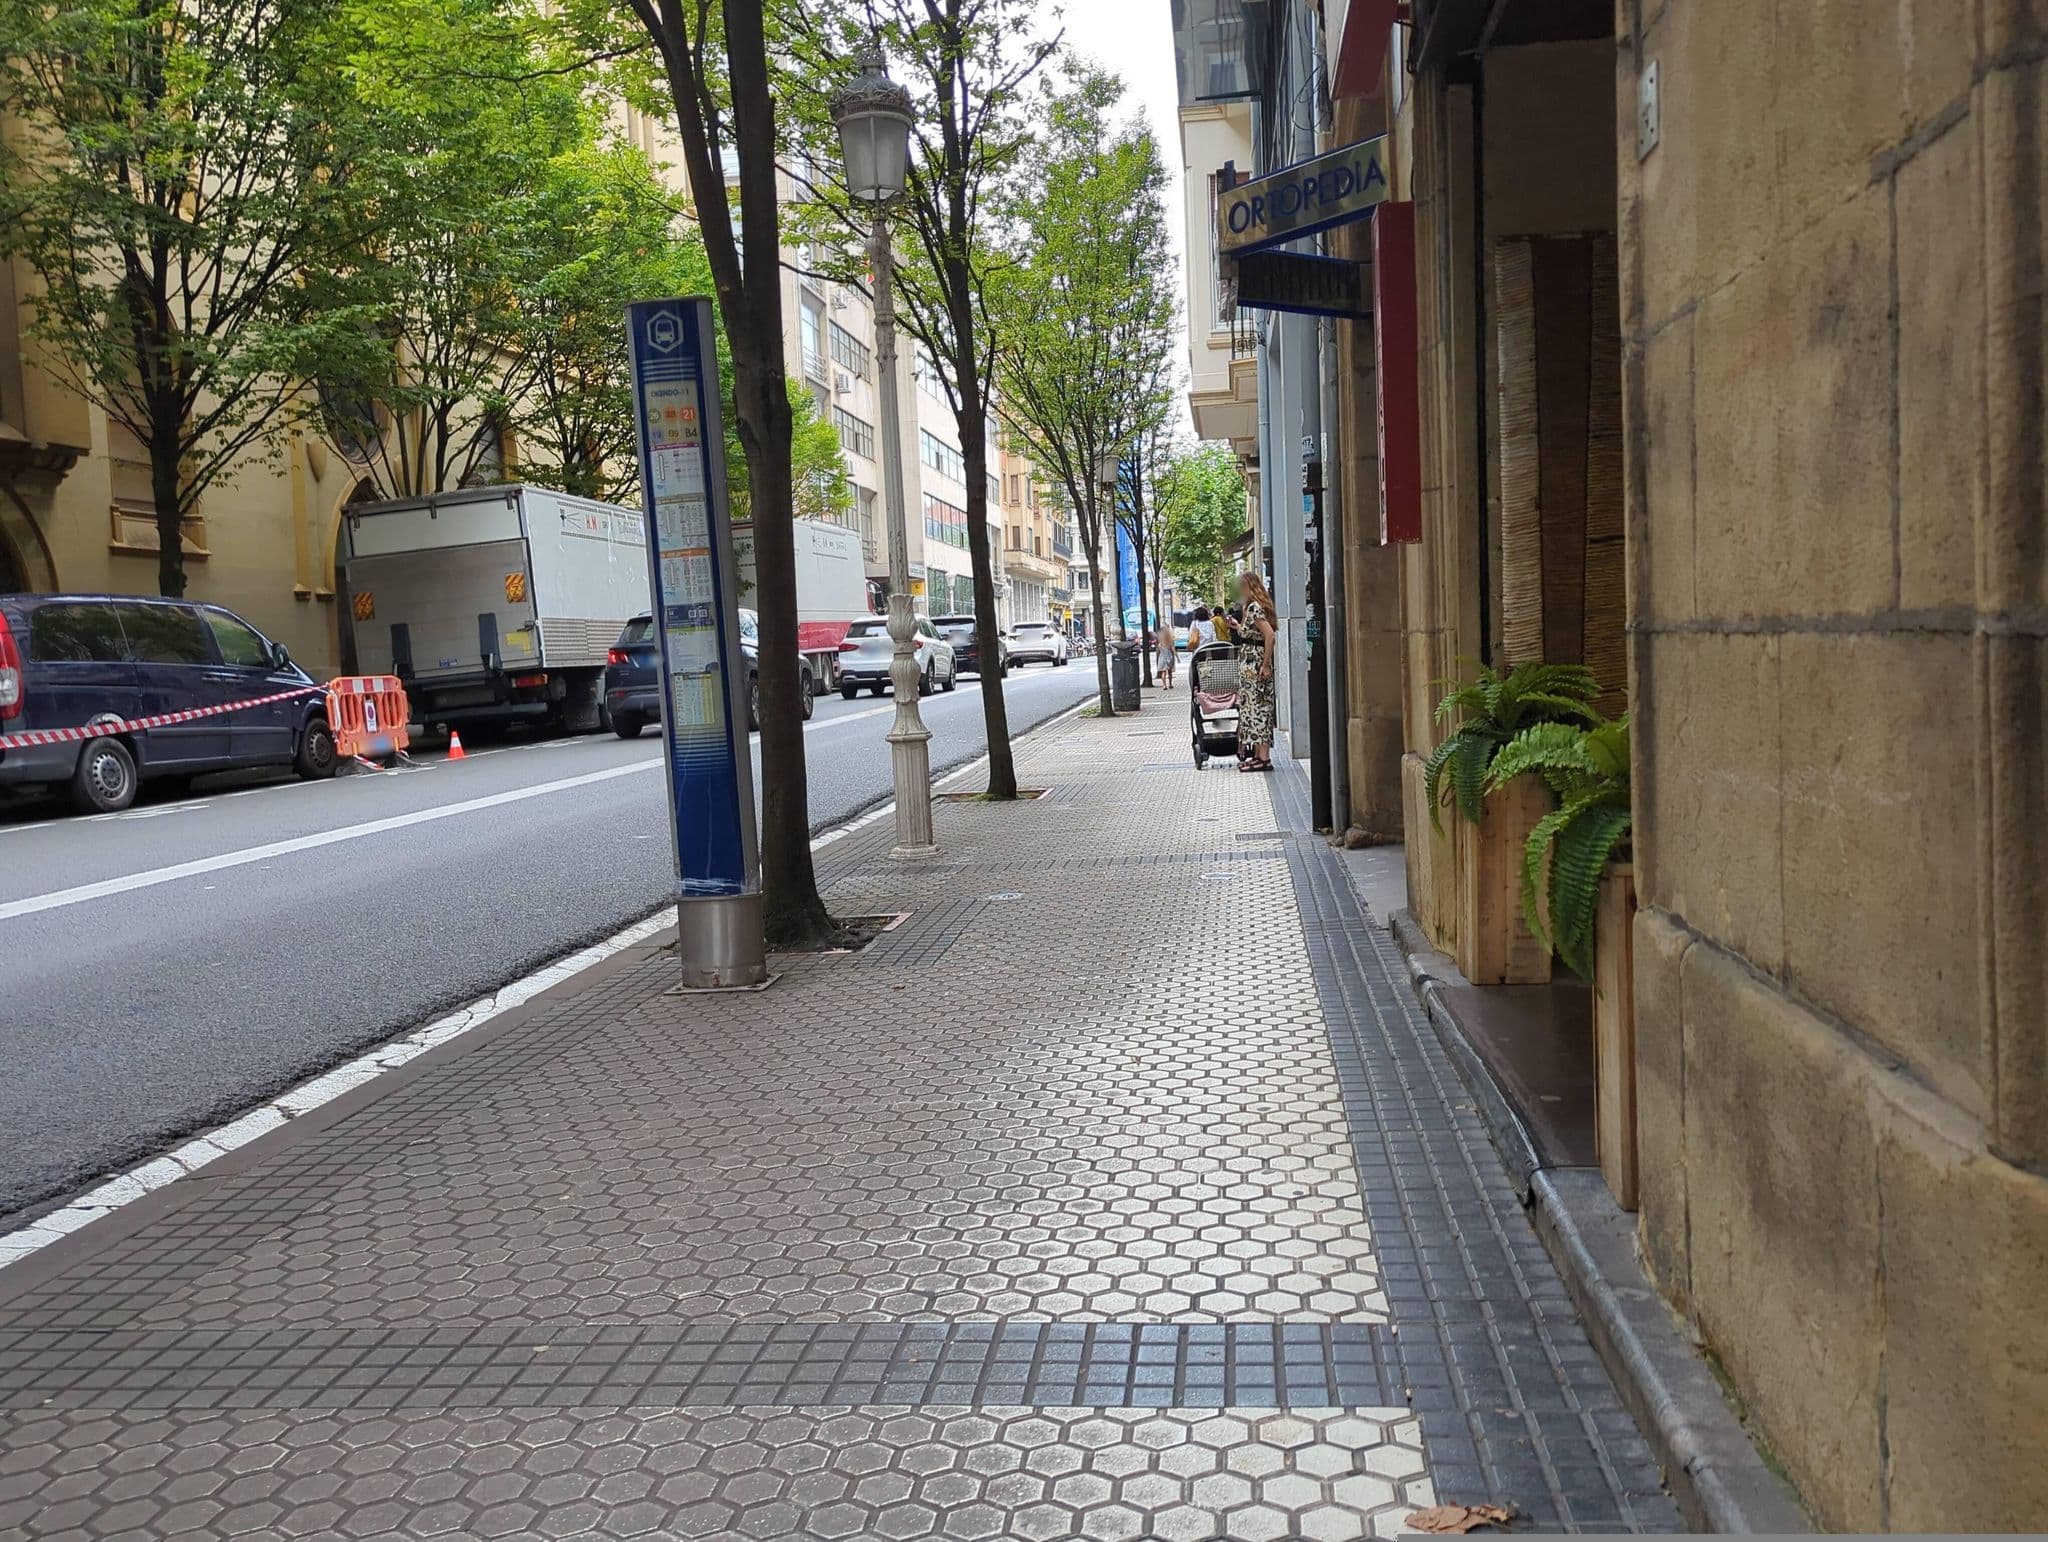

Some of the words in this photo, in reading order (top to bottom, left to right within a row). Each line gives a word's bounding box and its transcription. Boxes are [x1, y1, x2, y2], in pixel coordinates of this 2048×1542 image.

[1229, 155, 1385, 234] ORTOPEDIA
[682, 408, 694, 419] 21
[685, 427, 697, 438] B4
